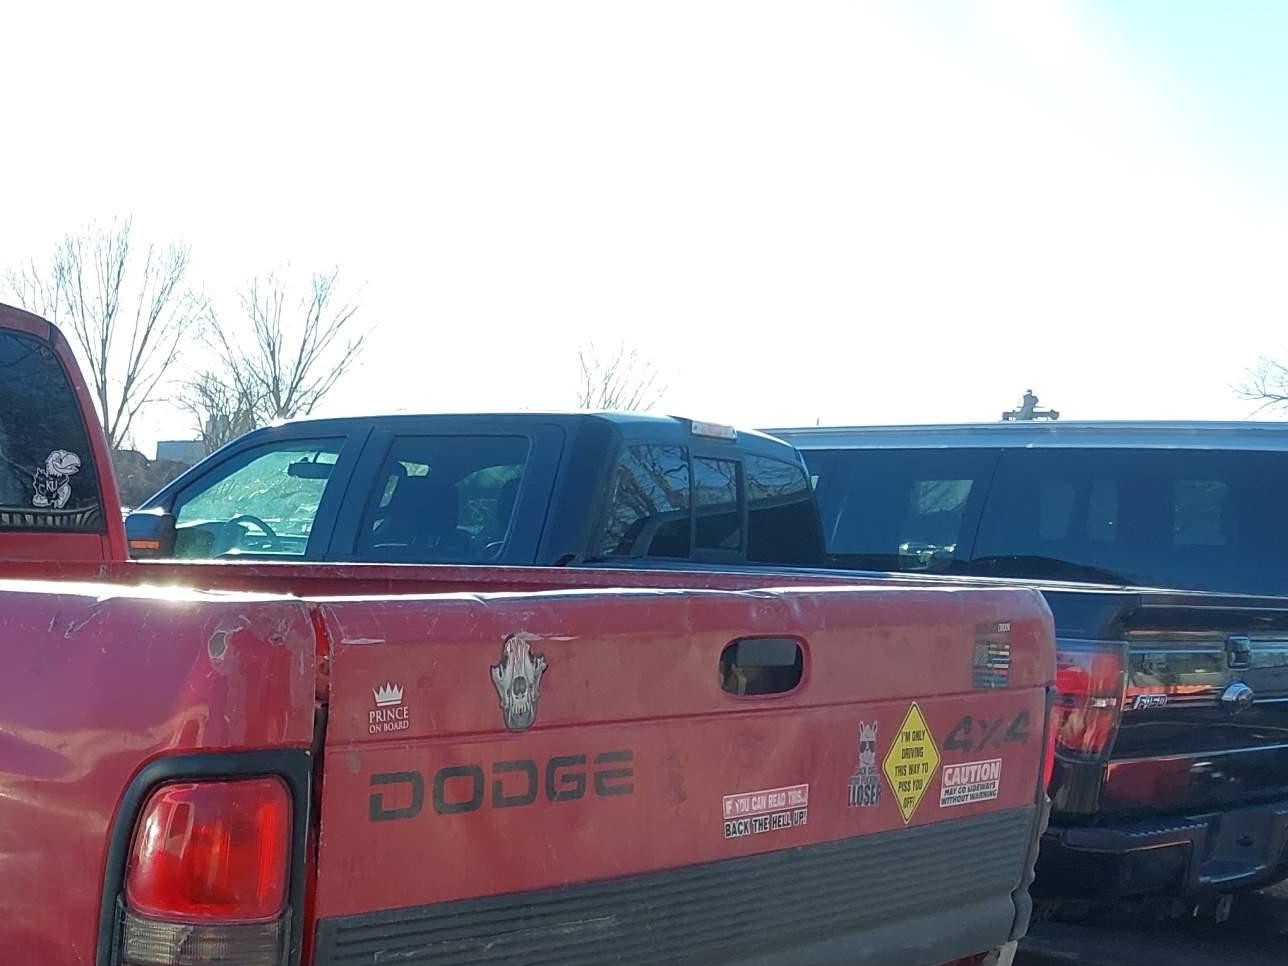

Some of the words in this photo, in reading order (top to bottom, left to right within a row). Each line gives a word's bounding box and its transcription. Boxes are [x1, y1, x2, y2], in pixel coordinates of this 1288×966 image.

[46, 480, 58, 492] KU
[369, 706, 409, 723] PRINCE
[369, 724, 382, 733] ON
[383, 720, 409, 732] BOARD
[912, 730, 925, 741] ONLY
[901, 747, 924, 759] DRIVING
[895, 765, 907, 777] THIS
[909, 763, 920, 775] WAY
[922, 762, 929, 774] TO
[944, 762, 999, 786] CAUTION
[368, 749, 633, 822] DODGE
[898, 781, 911, 793] PISS
[912, 779, 923, 791] YOU
[944, 786, 958, 796] MAY
[957, 785, 967, 794] GO
[967, 781, 996, 793] SIDEWAYS
[734, 799, 750, 813] YOU
[752, 795, 767, 810] CAN
[768, 792, 786, 808] READ
[941, 793, 969, 805] WITHOUT
[969, 789, 997, 801] WARNING
[725, 819, 751, 838] BACK
[753, 815, 769, 833] THE
[771, 811, 792, 830] HELL
